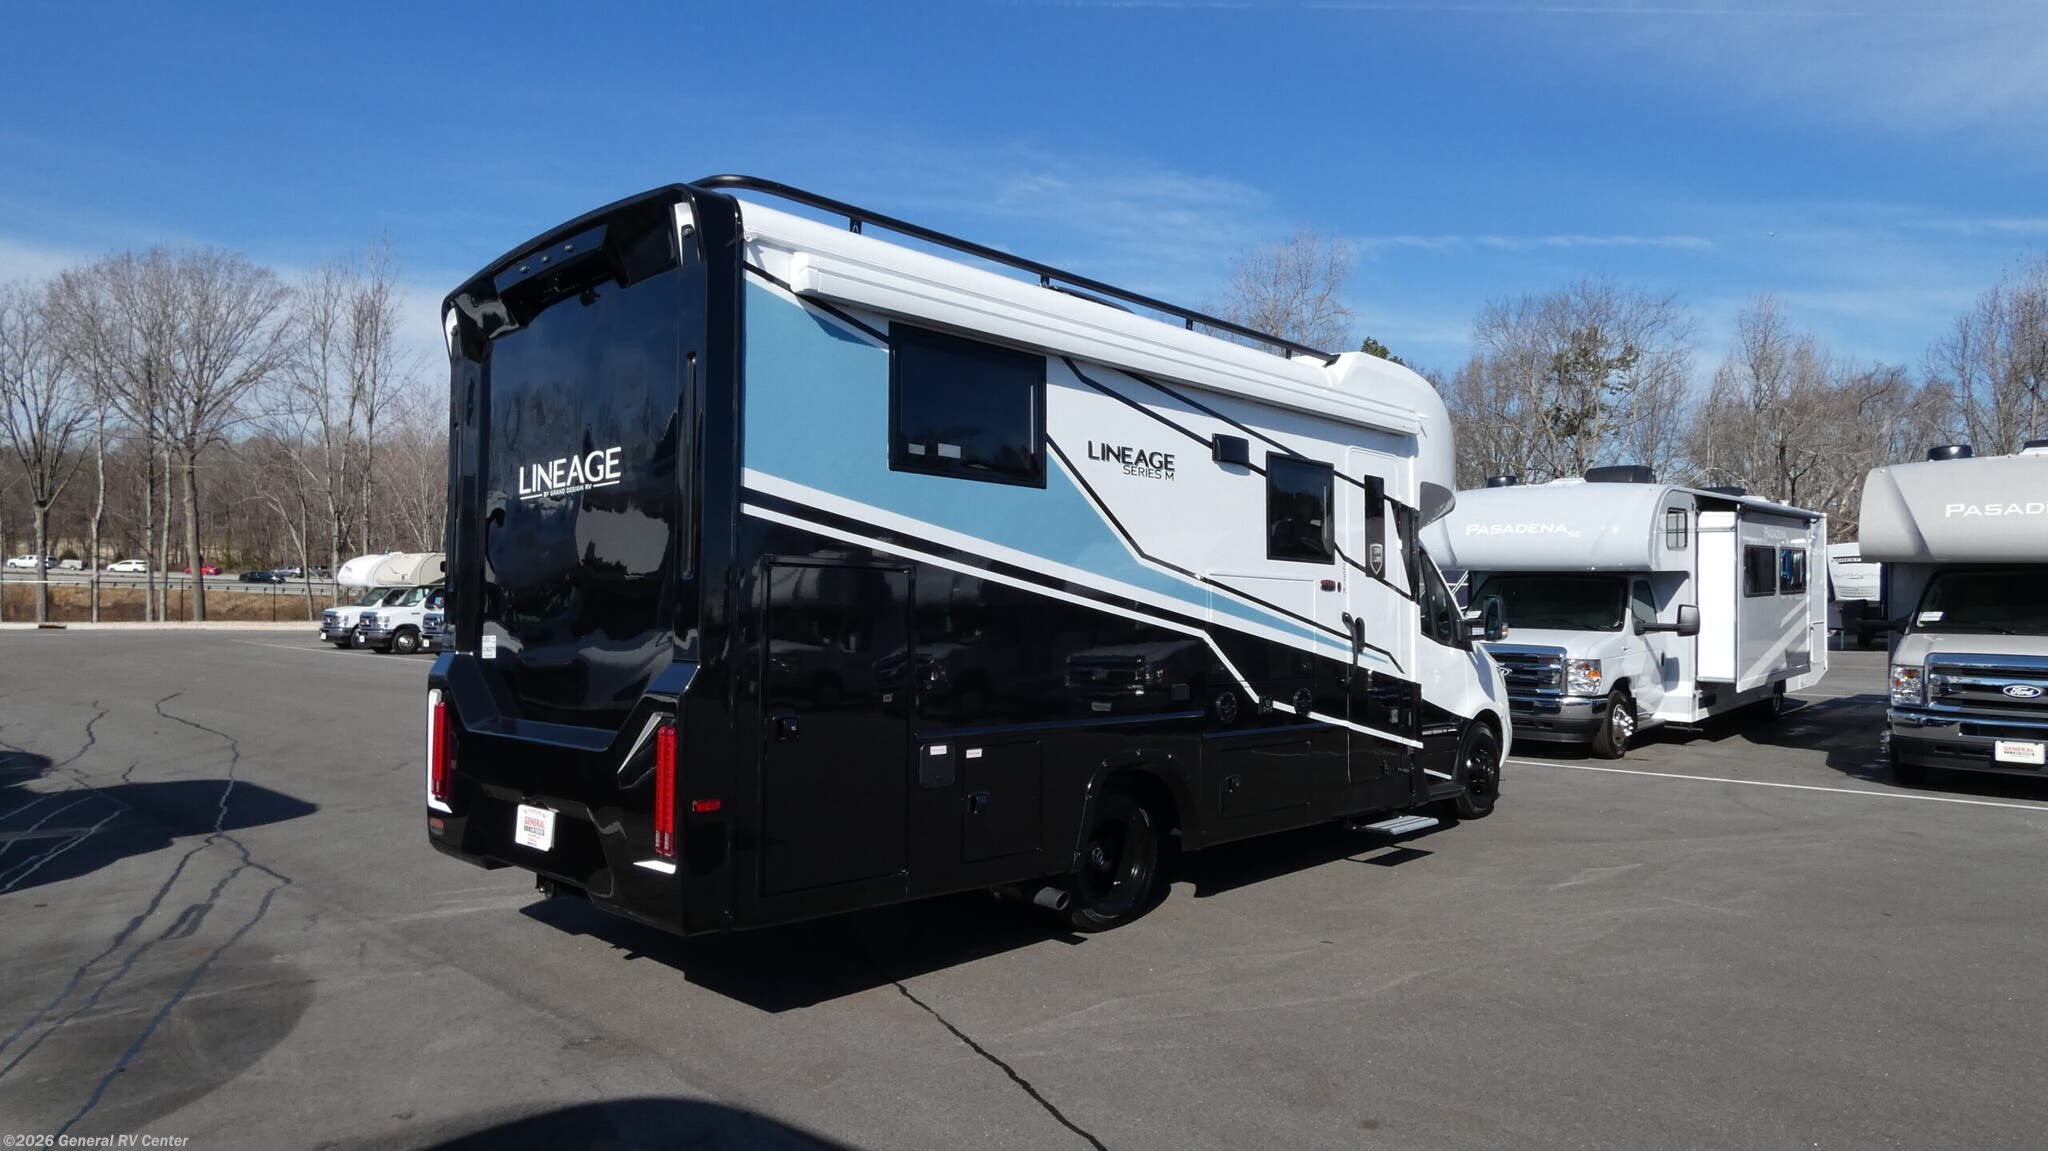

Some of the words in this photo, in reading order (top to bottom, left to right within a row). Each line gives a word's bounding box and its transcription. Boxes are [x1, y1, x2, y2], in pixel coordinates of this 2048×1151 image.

[1087, 440, 1176, 471] LINEAGE
[520, 446, 622, 494] LINEAGE
[1122, 464, 1162, 479] SERIES
[1165, 471, 1175, 481] M
[1945, 502, 2048, 518] PASAD
[1465, 522, 1568, 536] PASADENA
[524, 816, 545, 829] GENERAL
